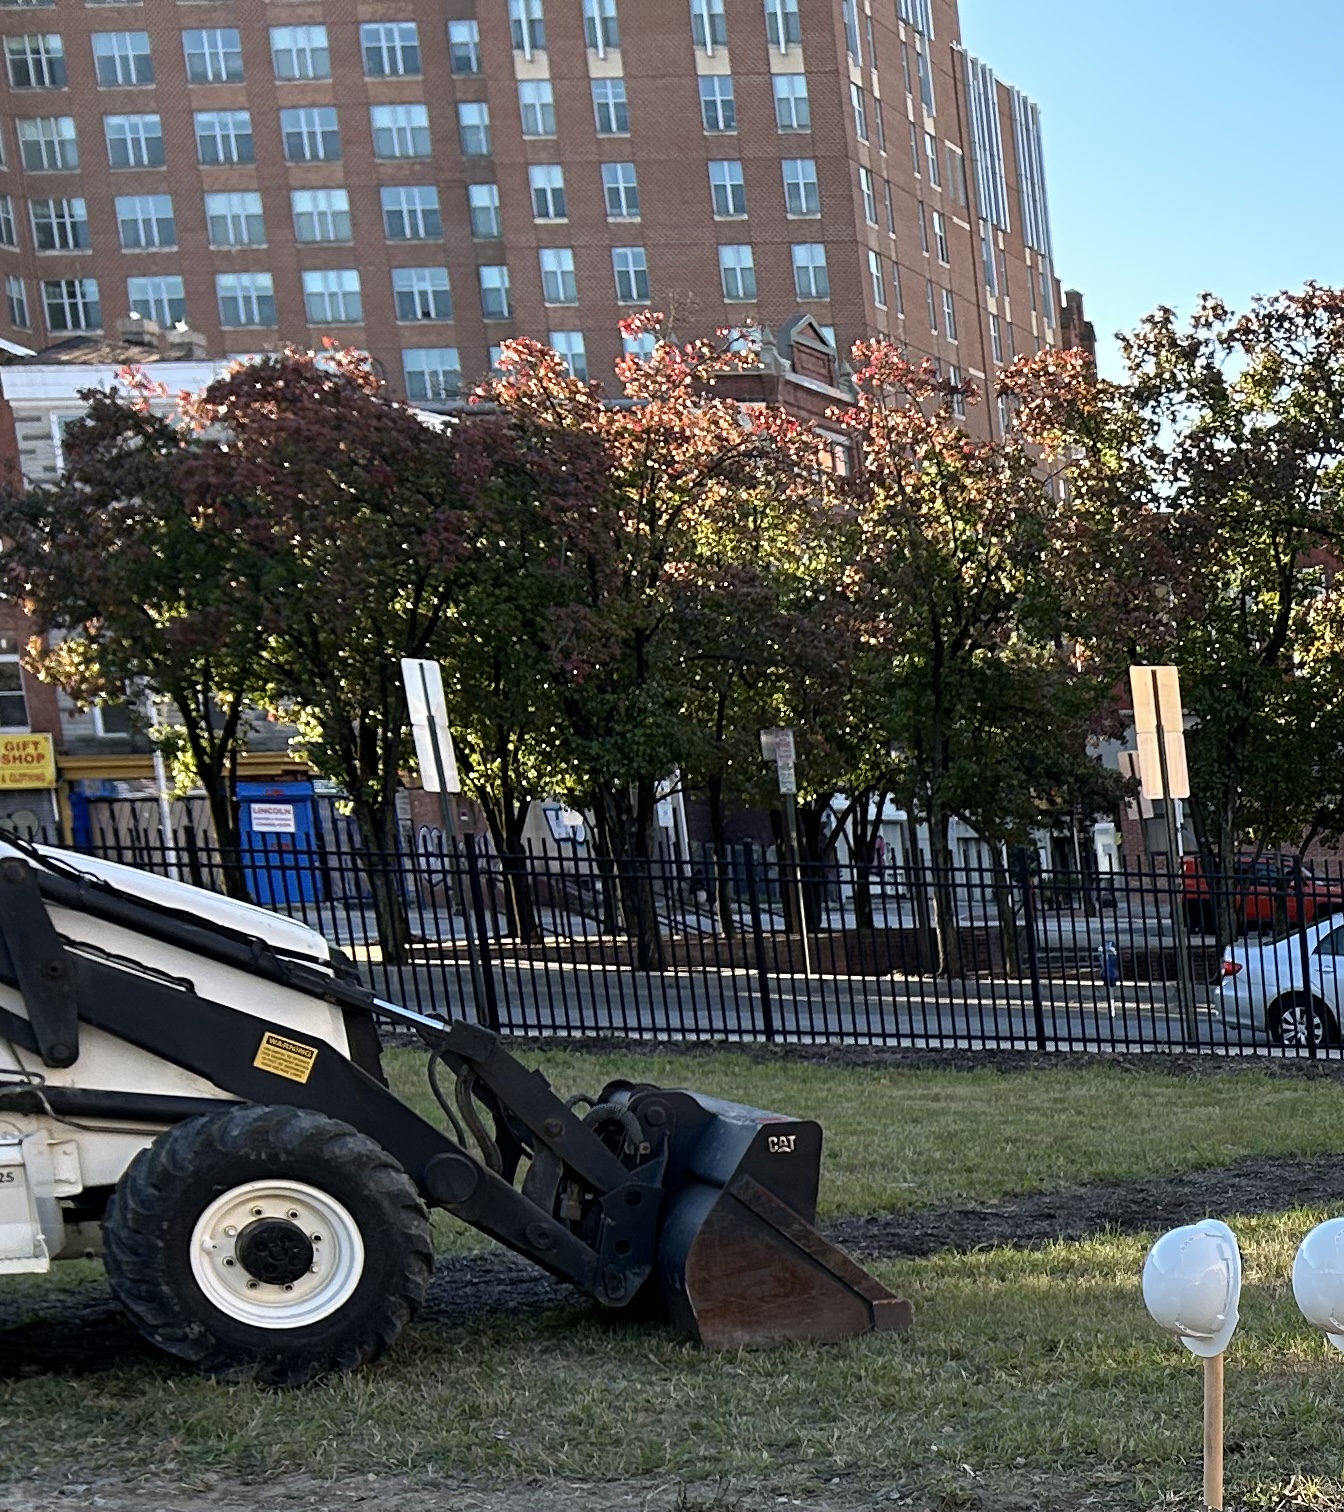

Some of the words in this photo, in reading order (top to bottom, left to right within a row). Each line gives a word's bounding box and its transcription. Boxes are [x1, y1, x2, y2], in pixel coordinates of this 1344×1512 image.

[4, 740, 40, 752] GIFT
[1, 752, 45, 765] SHOP
[252, 807, 292, 816] LINCOLN
[268, 1037, 313, 1058] WARNING
[768, 1135, 797, 1153] CAT
